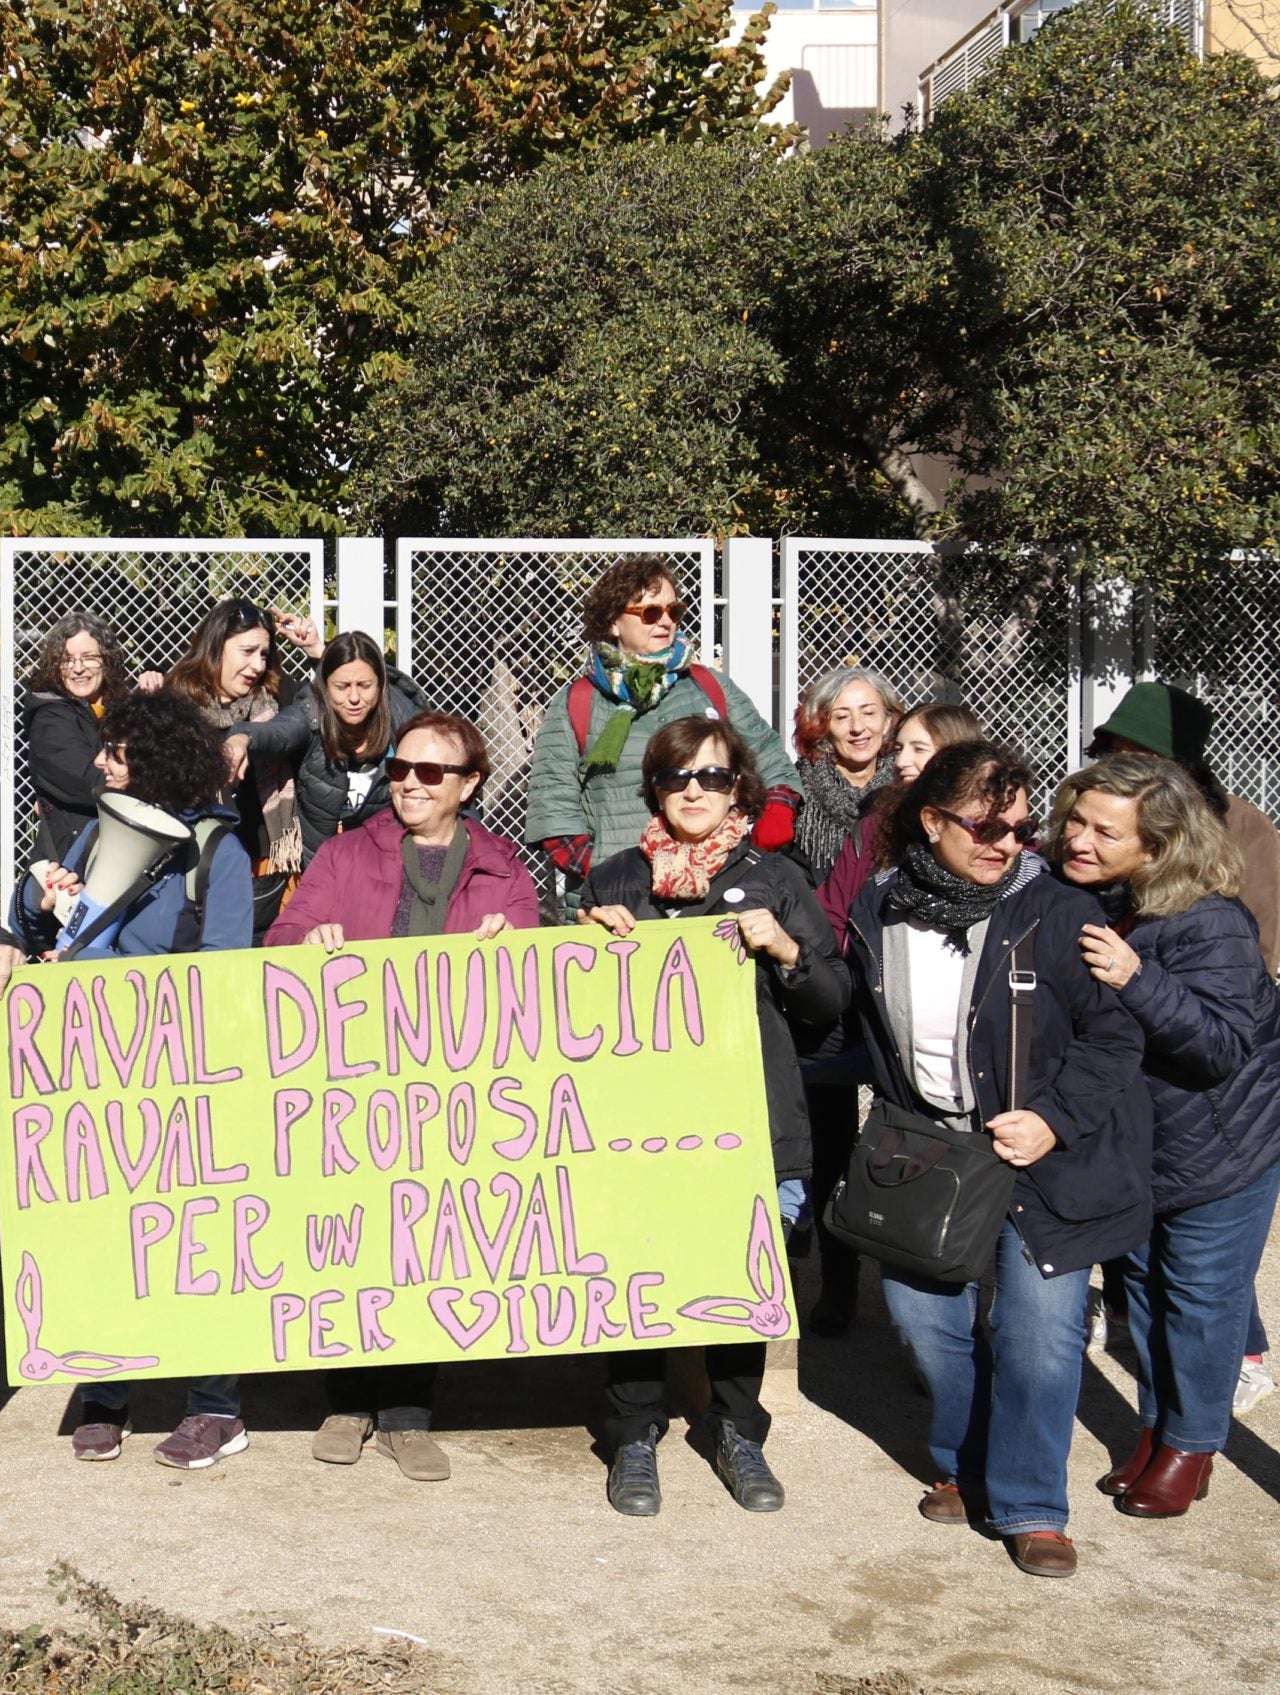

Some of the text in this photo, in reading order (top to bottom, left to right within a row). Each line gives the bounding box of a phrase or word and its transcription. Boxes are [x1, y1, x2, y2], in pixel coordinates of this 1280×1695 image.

[7, 935, 705, 1099] RAVAL DENUNCIA
[13, 1094, 249, 1210] RAVAL
[129, 1195, 285, 1299] PER
[390, 1166, 608, 1287] RAVAL
[271, 1287, 396, 1363] PER
